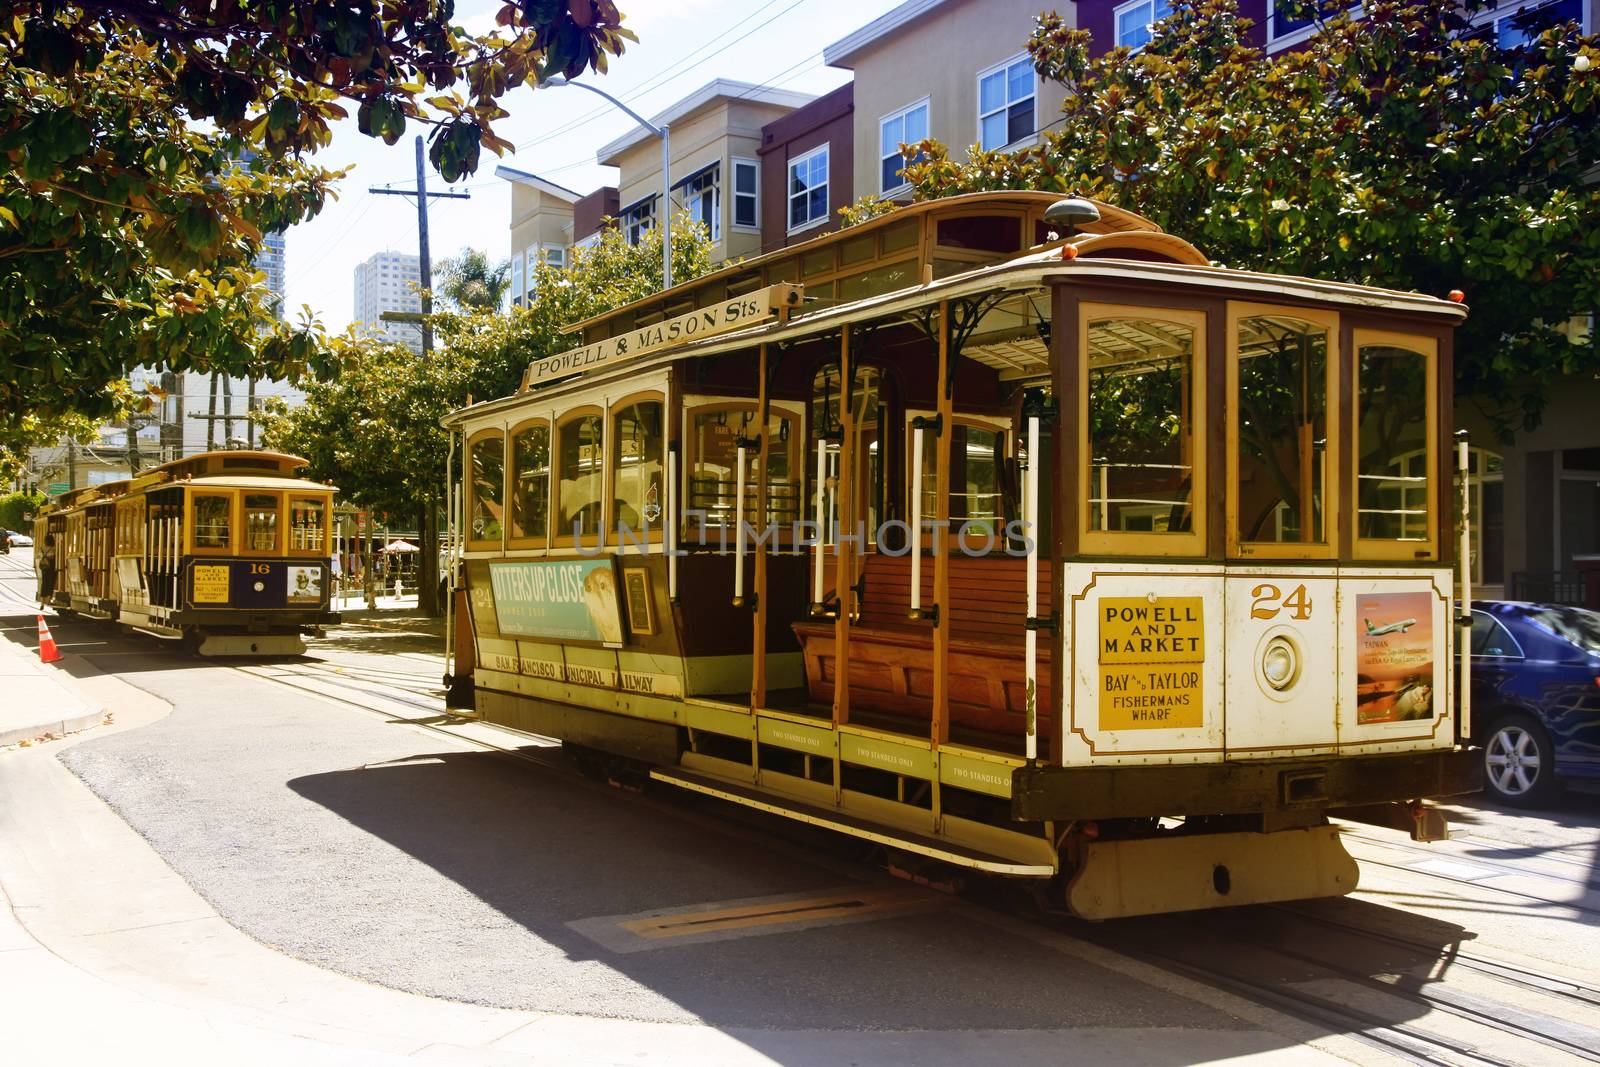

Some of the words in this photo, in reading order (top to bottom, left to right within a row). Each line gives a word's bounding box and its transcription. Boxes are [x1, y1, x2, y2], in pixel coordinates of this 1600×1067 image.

[538, 345, 607, 377] POWELL
[615, 337, 628, 356] &
[637, 309, 718, 349] MASON
[724, 299, 761, 322] Sts.
[250, 563, 271, 575] 16
[492, 566, 532, 602] OTTERS
[546, 564, 585, 603] CLOSE
[475, 587, 493, 608] 24
[1251, 584, 1312, 620] 24
[1106, 607, 1197, 622] POWELL
[1131, 625, 1176, 636] AND
[1105, 638, 1200, 653] MARKET
[495, 656, 510, 670] SAN
[512, 658, 555, 677] FANCISCO
[1106, 675, 1129, 692] BAY
[1148, 672, 1198, 690] TAYLOR
[1113, 694, 1190, 708] FISHERMANS
[1132, 708, 1171, 721] WHARF
[773, 730, 783, 740] TWO
[784, 732, 807, 744] STANDEES
[807, 737, 820, 746] ONLY
[857, 747, 870, 758] TWO
[871, 751, 897, 764] STANDEES
[898, 758, 913, 767] ONLY
[953, 767, 968, 777] TWO
[969, 771, 1001, 785] STANDEES
